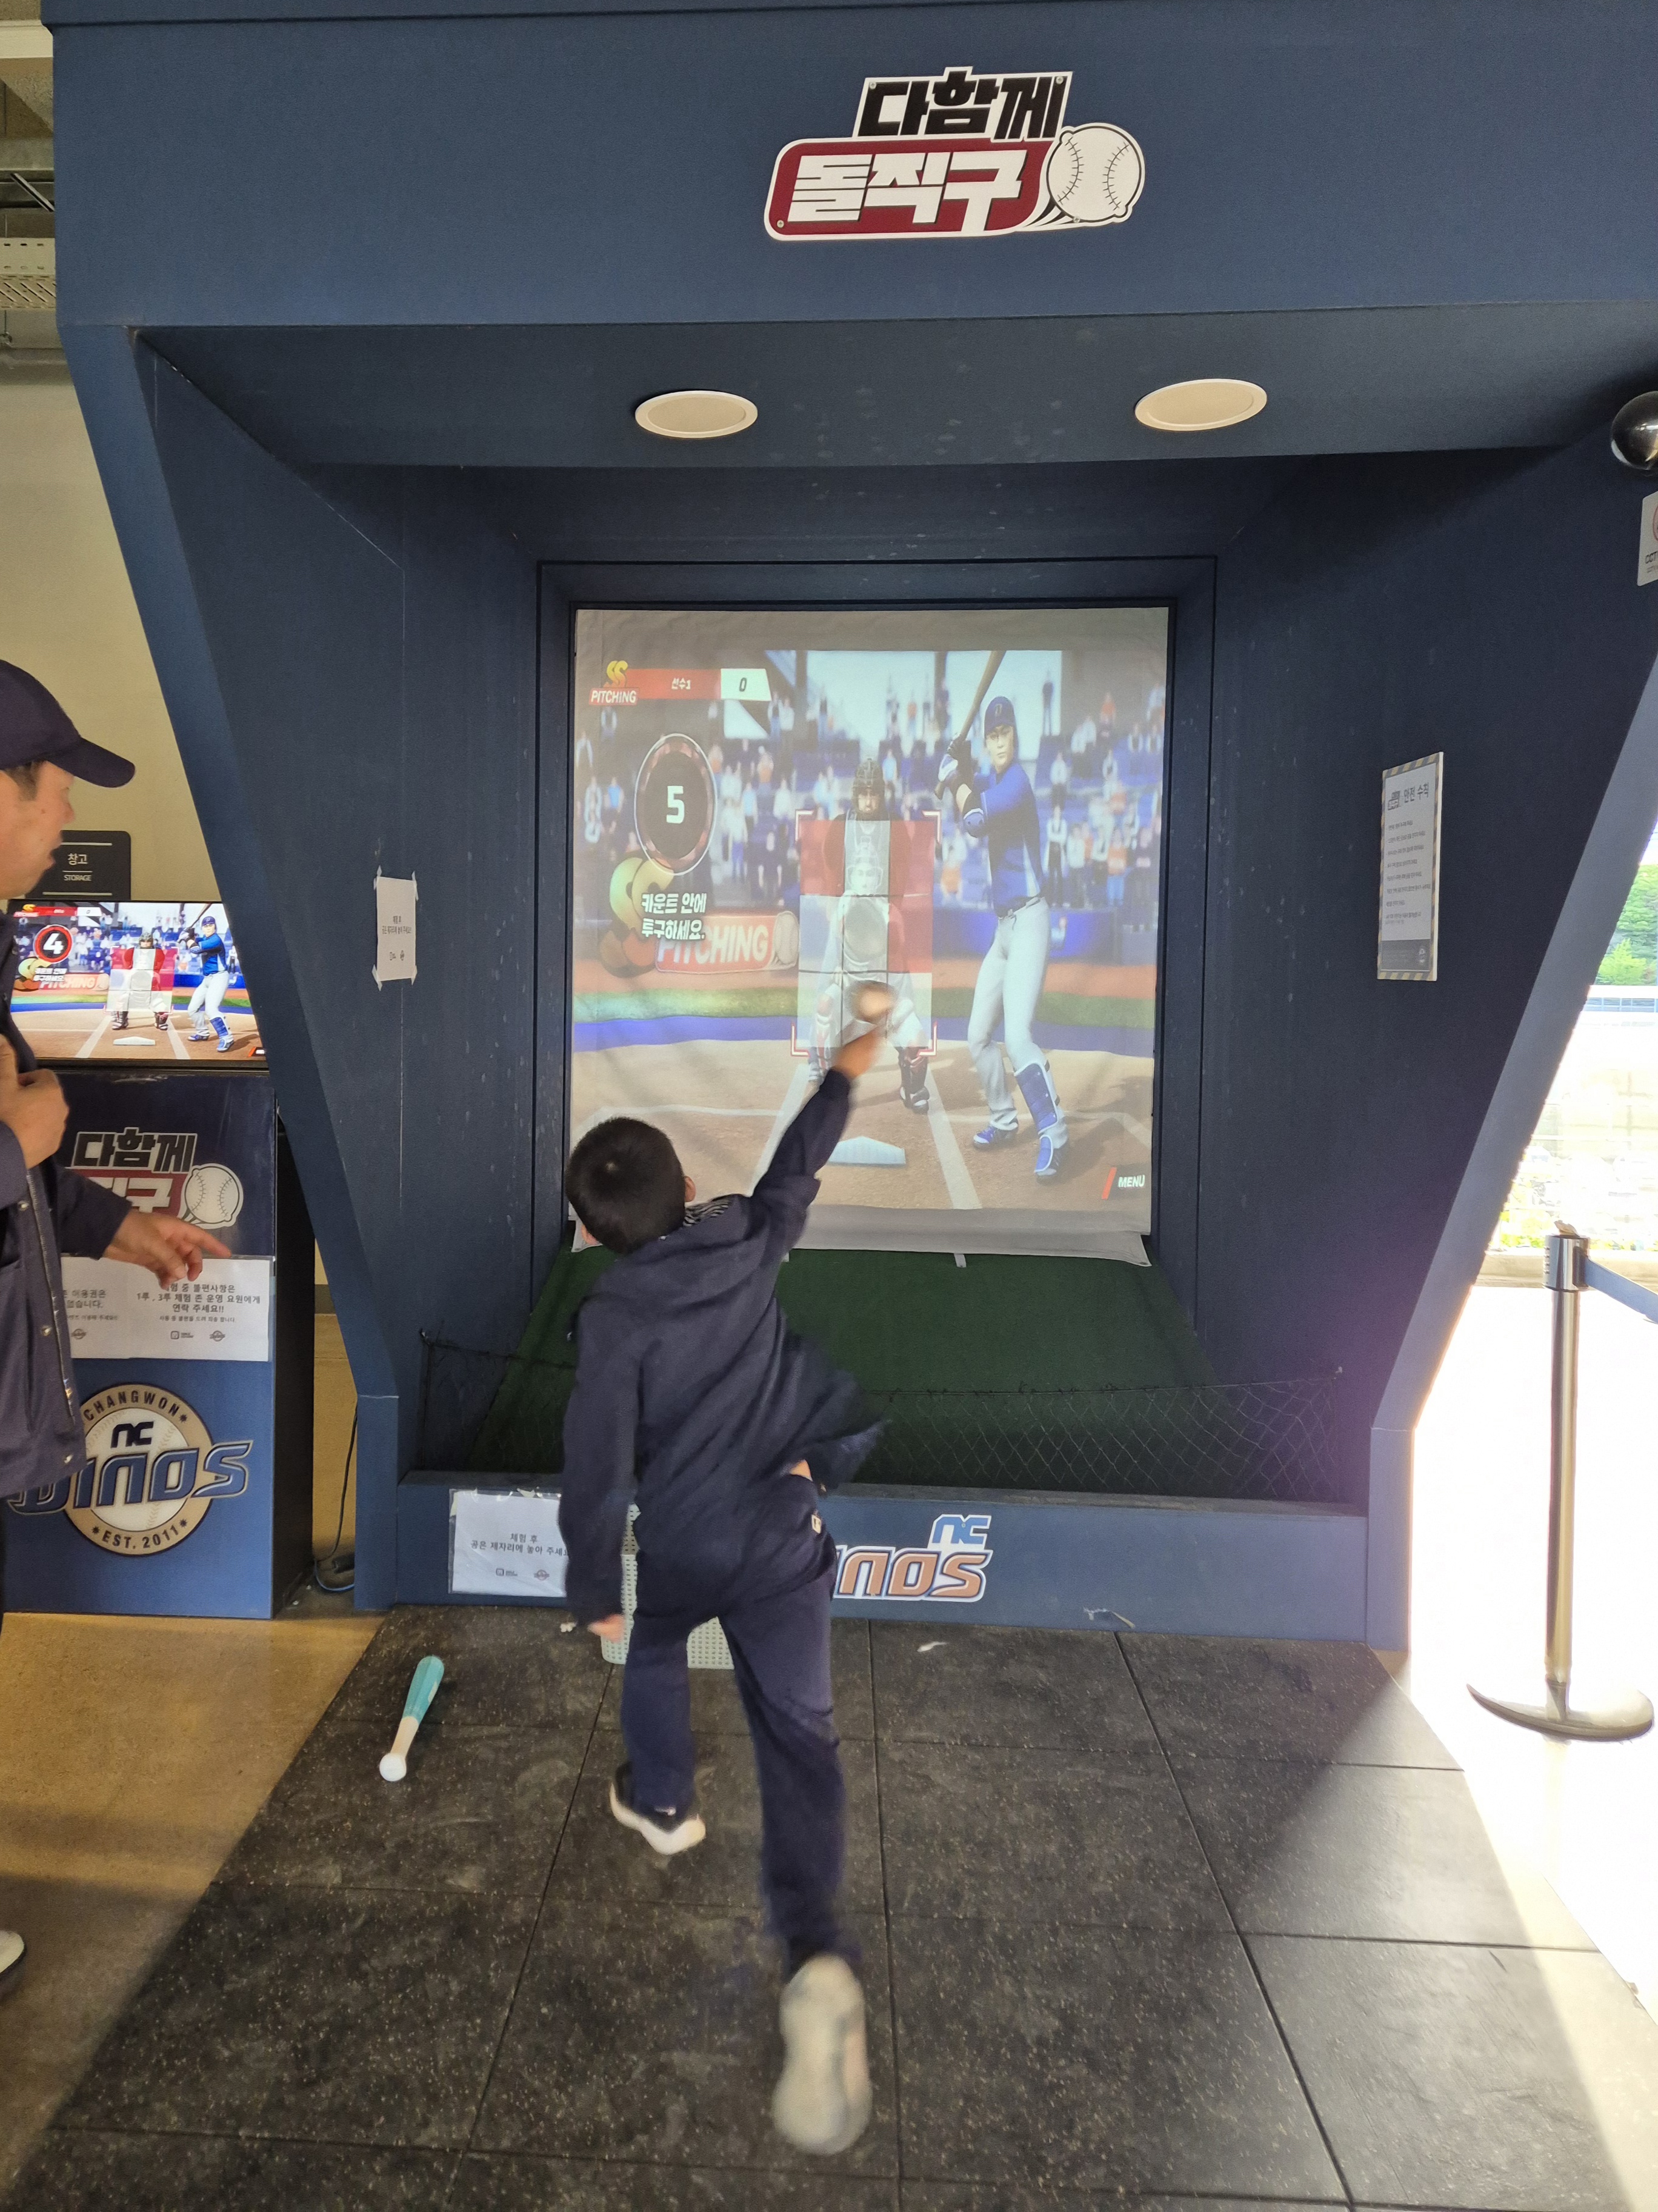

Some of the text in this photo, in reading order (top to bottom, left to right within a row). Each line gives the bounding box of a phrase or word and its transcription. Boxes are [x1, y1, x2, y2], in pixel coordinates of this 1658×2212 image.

[857, 70, 1065, 140] 다함께
[787, 150, 1028, 232] 돌직구
[1645, 551, 1658, 564] CCT
[739, 677, 747, 692] 0
[590, 690, 637, 704] PITCHING
[666, 785, 685, 824] 5
[67, 853, 88, 865] 창고
[641, 893, 707, 914] 카운트 안에
[641, 918, 705, 940] 투구하세요.
[42, 933, 64, 954] 4
[73, 1128, 196, 1173] 다함께
[1117, 1174, 1145, 1188] MENU
[175, 1293, 191, 1302] 체험
[207, 1294, 224, 1303] 운영
[227, 1294, 261, 1304] 요원에게
[172, 1304, 224, 1313] 연락 주세요!!
[84, 1390, 180, 1422] CHANGWON
[102, 1524, 179, 1550] EST. 2011
[510, 1533, 538, 1544] 체험 후
[470, 1540, 487, 1550] 공은
[490, 1542, 524, 1553] 제자리에
[527, 1545, 543, 1555] 놓아
